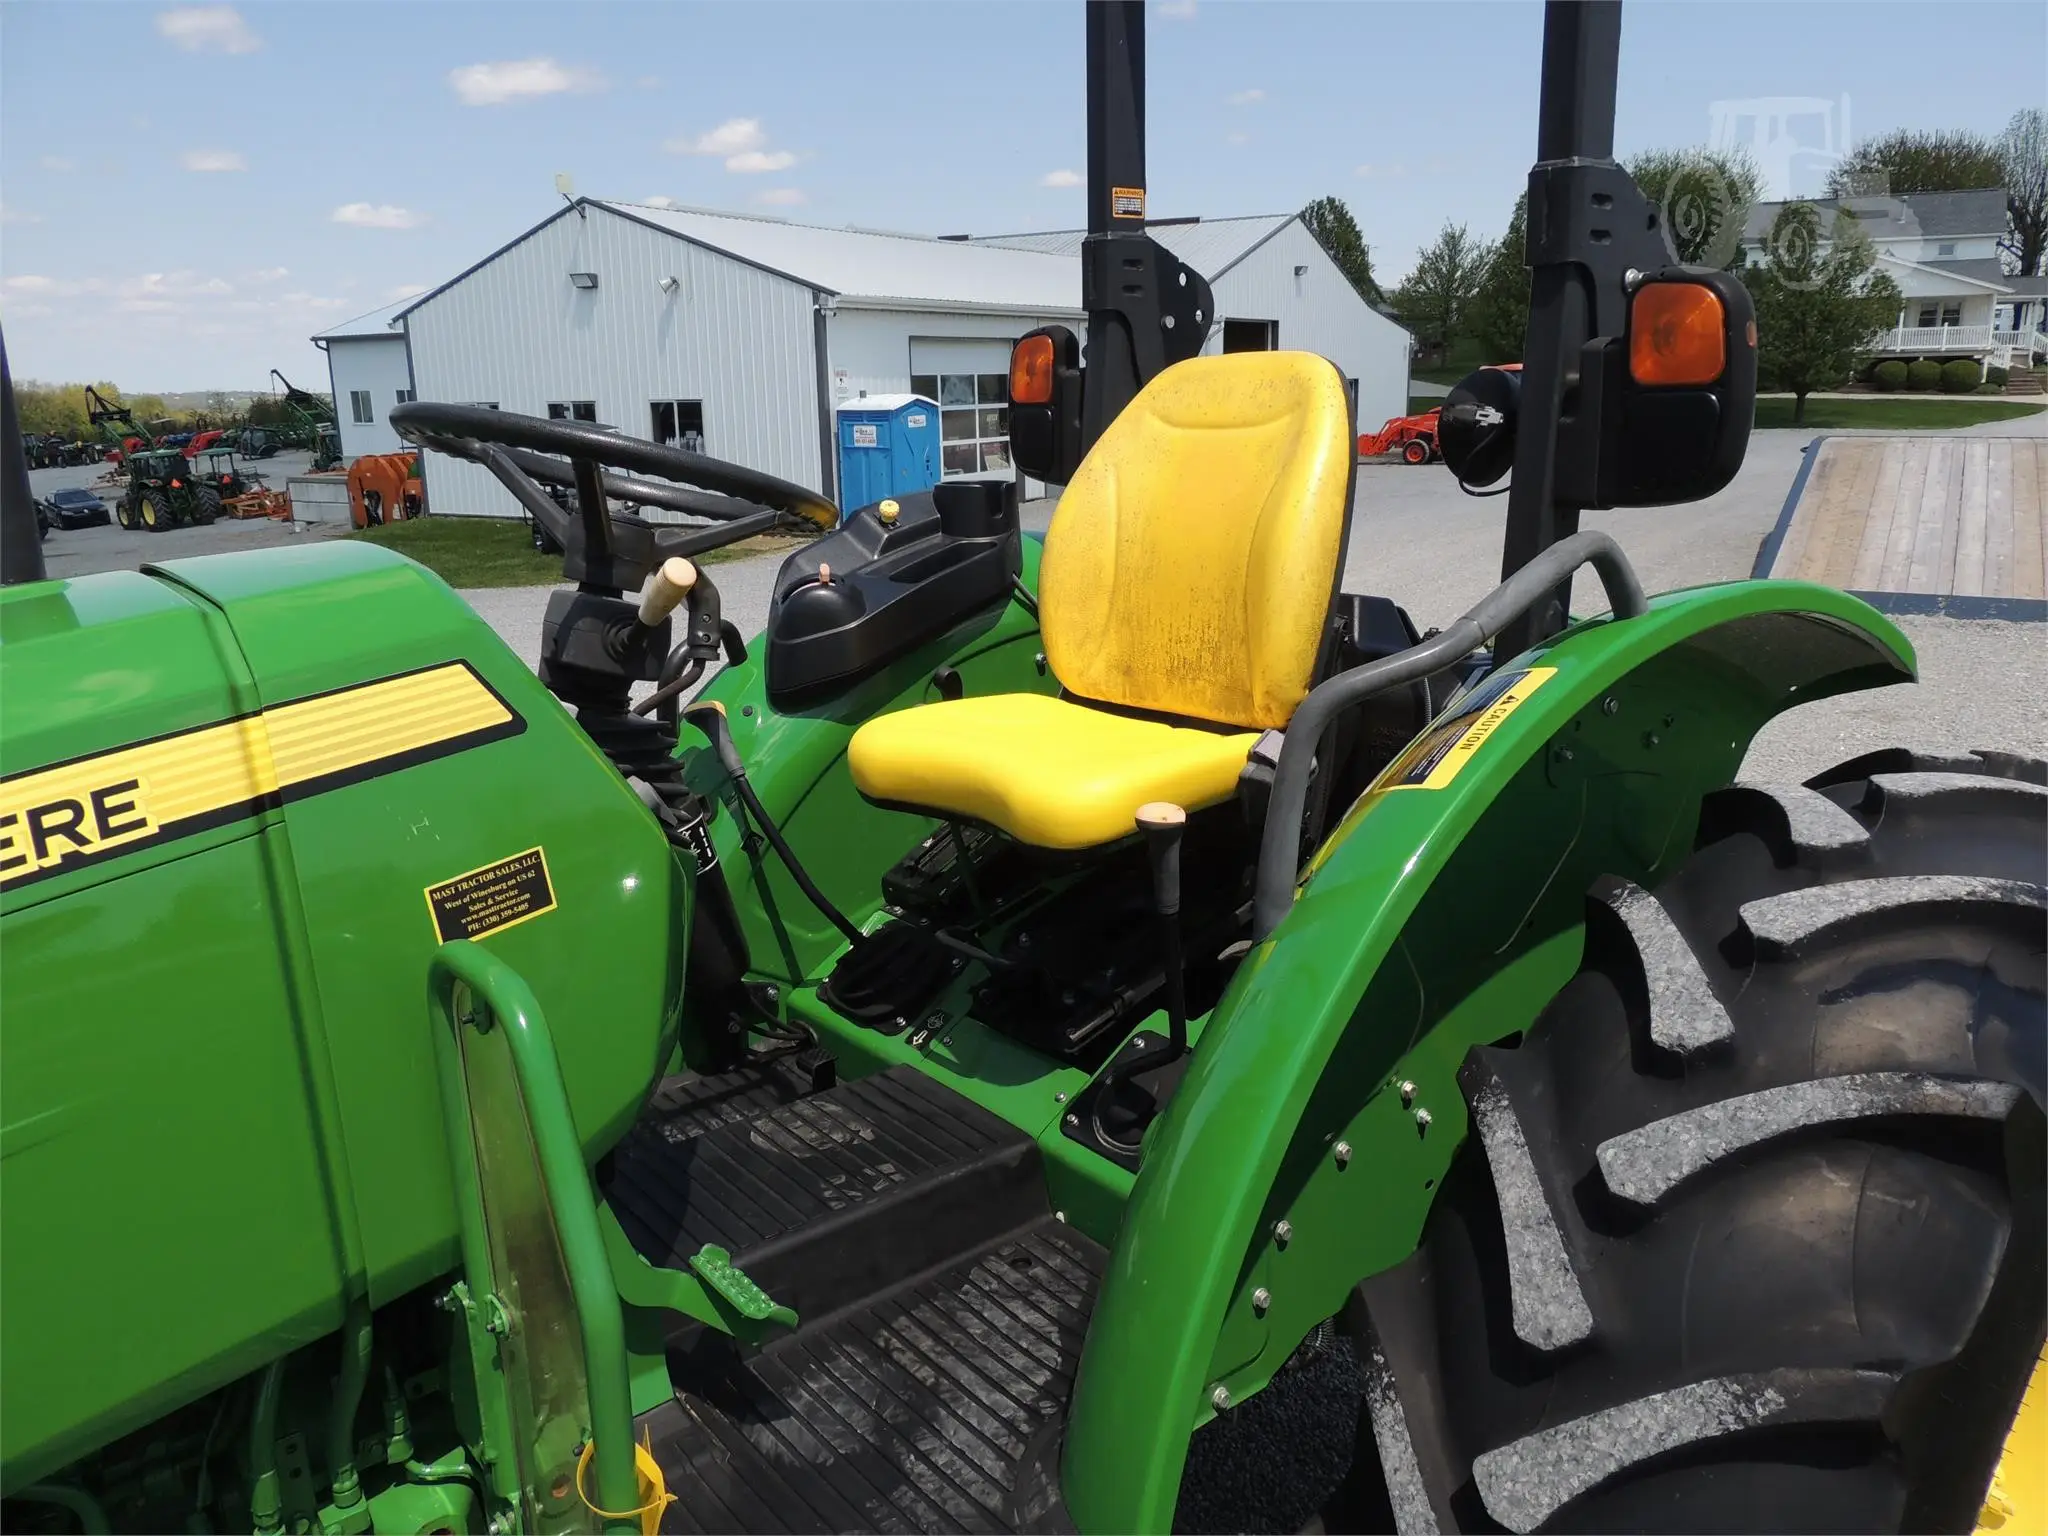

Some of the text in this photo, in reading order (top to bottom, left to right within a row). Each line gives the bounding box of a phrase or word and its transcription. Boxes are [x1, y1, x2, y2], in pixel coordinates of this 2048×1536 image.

[1459, 708, 1507, 750] CAUTION
[432, 854, 541, 901] MAST TRACTOR SALES, LLC.
[444, 869, 536, 910] West of Winesburg on US 62
[460, 891, 531, 925] www.masttractor.com
[467, 902, 529, 933] PH: (330) 359-5405
[468, 888, 519, 913] Sales & Service
